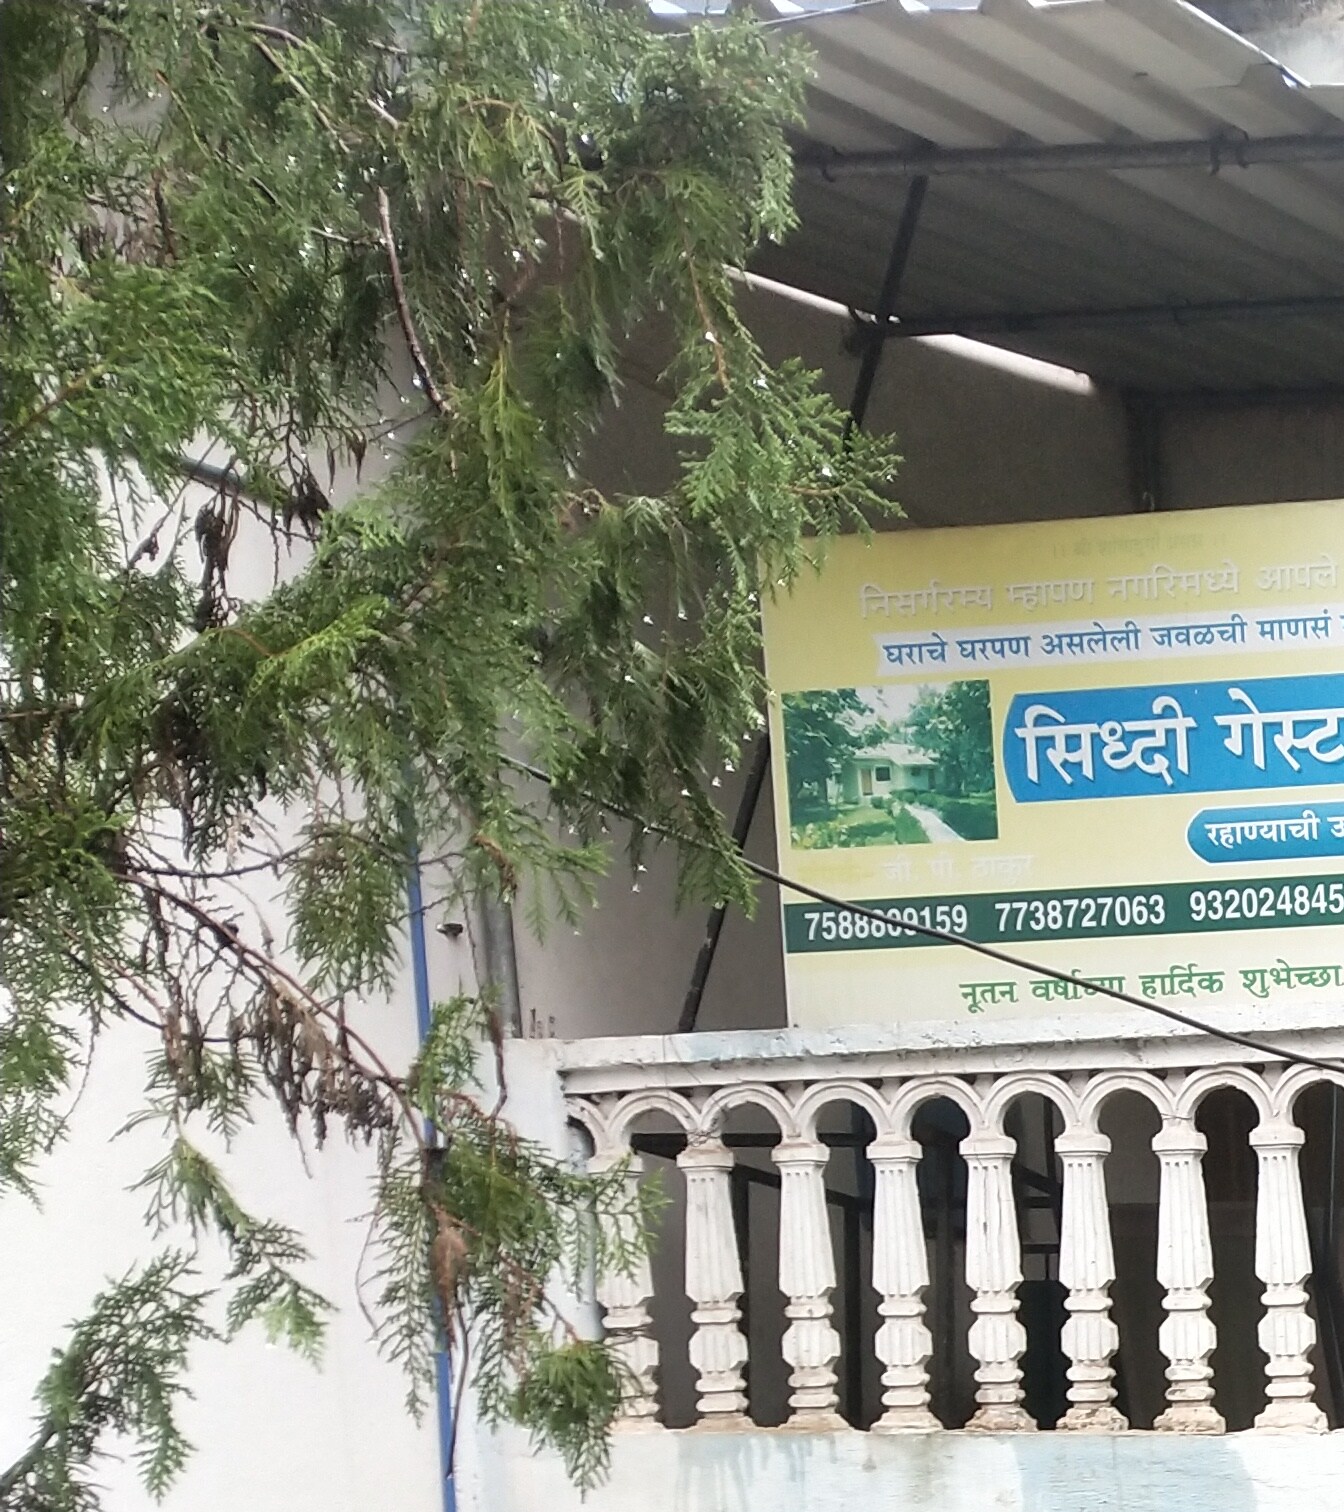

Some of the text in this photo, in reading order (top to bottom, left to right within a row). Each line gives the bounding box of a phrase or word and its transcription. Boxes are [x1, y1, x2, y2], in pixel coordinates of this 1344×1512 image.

[1257, 554, 1339, 591] आपले
[882, 631, 949, 666] घराचे
[955, 634, 1034, 661] घरपण
[1040, 620, 1142, 657] असलेली
[1149, 612, 1248, 648] जवळची
[1255, 608, 1332, 641] माणसं
[1204, 810, 1321, 849] रहाण्याची
[804, 904, 969, 941] 7588809159
[994, 894, 1167, 932] 7738727063
[959, 981, 1019, 1014] नूतन
[1138, 963, 1225, 999] हार्दिक
[1238, 958, 1343, 998] शुभेच्छा
